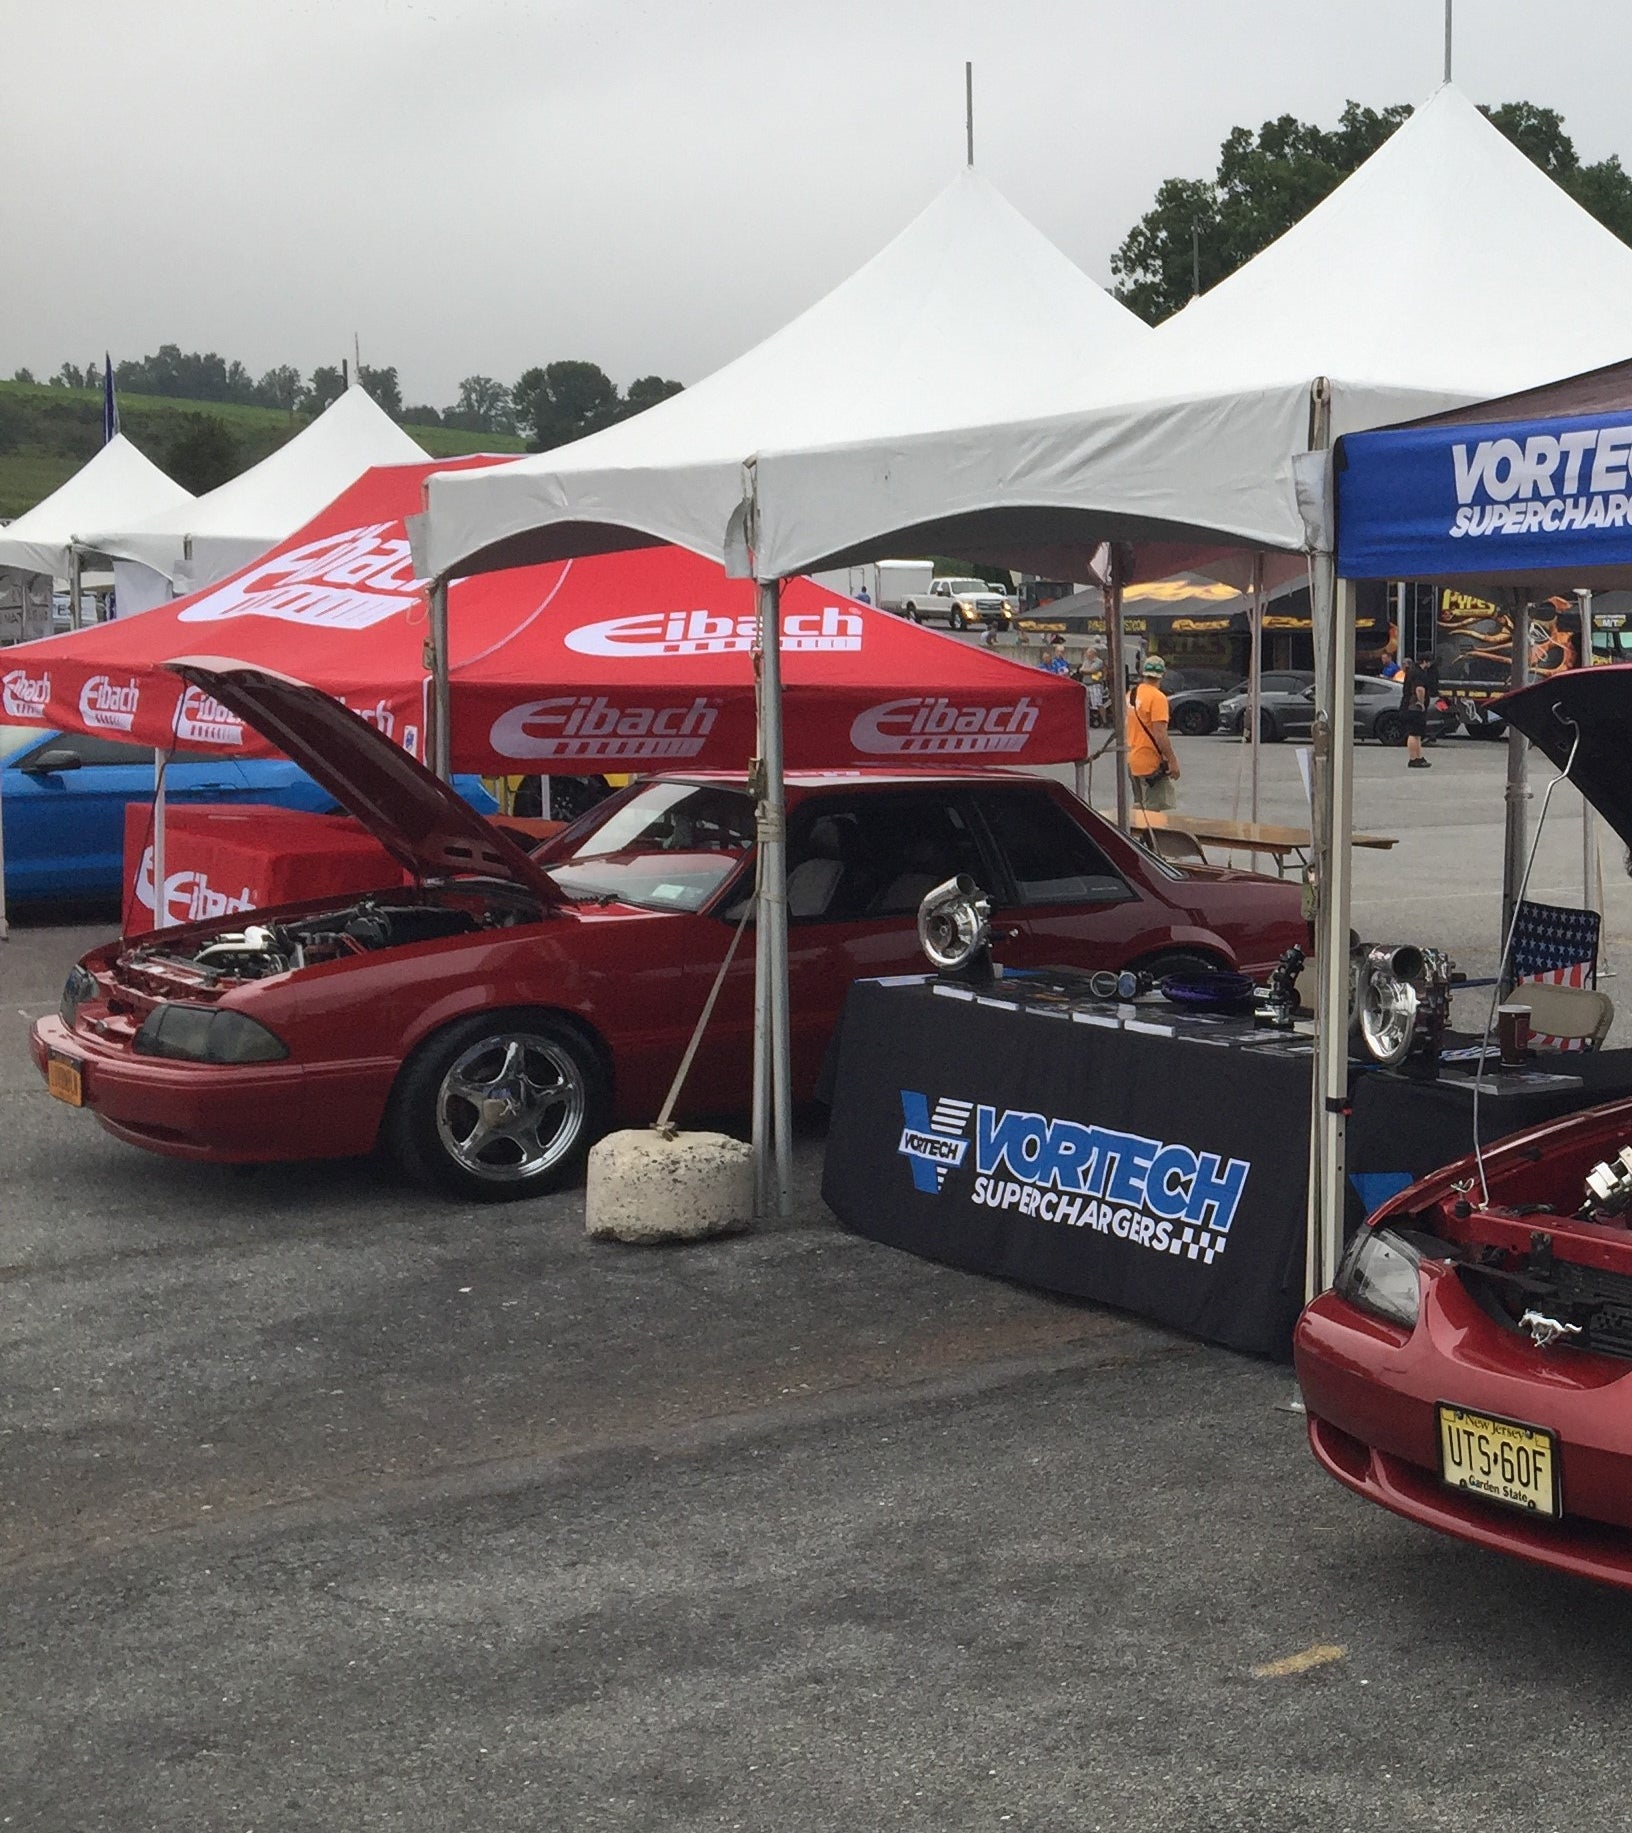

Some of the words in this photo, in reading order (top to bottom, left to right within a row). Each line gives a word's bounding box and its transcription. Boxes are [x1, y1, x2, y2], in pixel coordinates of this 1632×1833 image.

[79, 675, 139, 731] Eibach
[489, 696, 719, 758] Eibach
[849, 696, 1040, 753] Eibach
[904, 1132, 959, 1159] VORTECH
[975, 1103, 1251, 1233] VORTECH
[971, 1175, 1174, 1252] SUPERCHARGERS
[1465, 1414, 1490, 1430] New
[1491, 1420, 1525, 1441] Jersey
[1468, 1475, 1500, 1495] Garden
[1502, 1485, 1528, 1502] State
